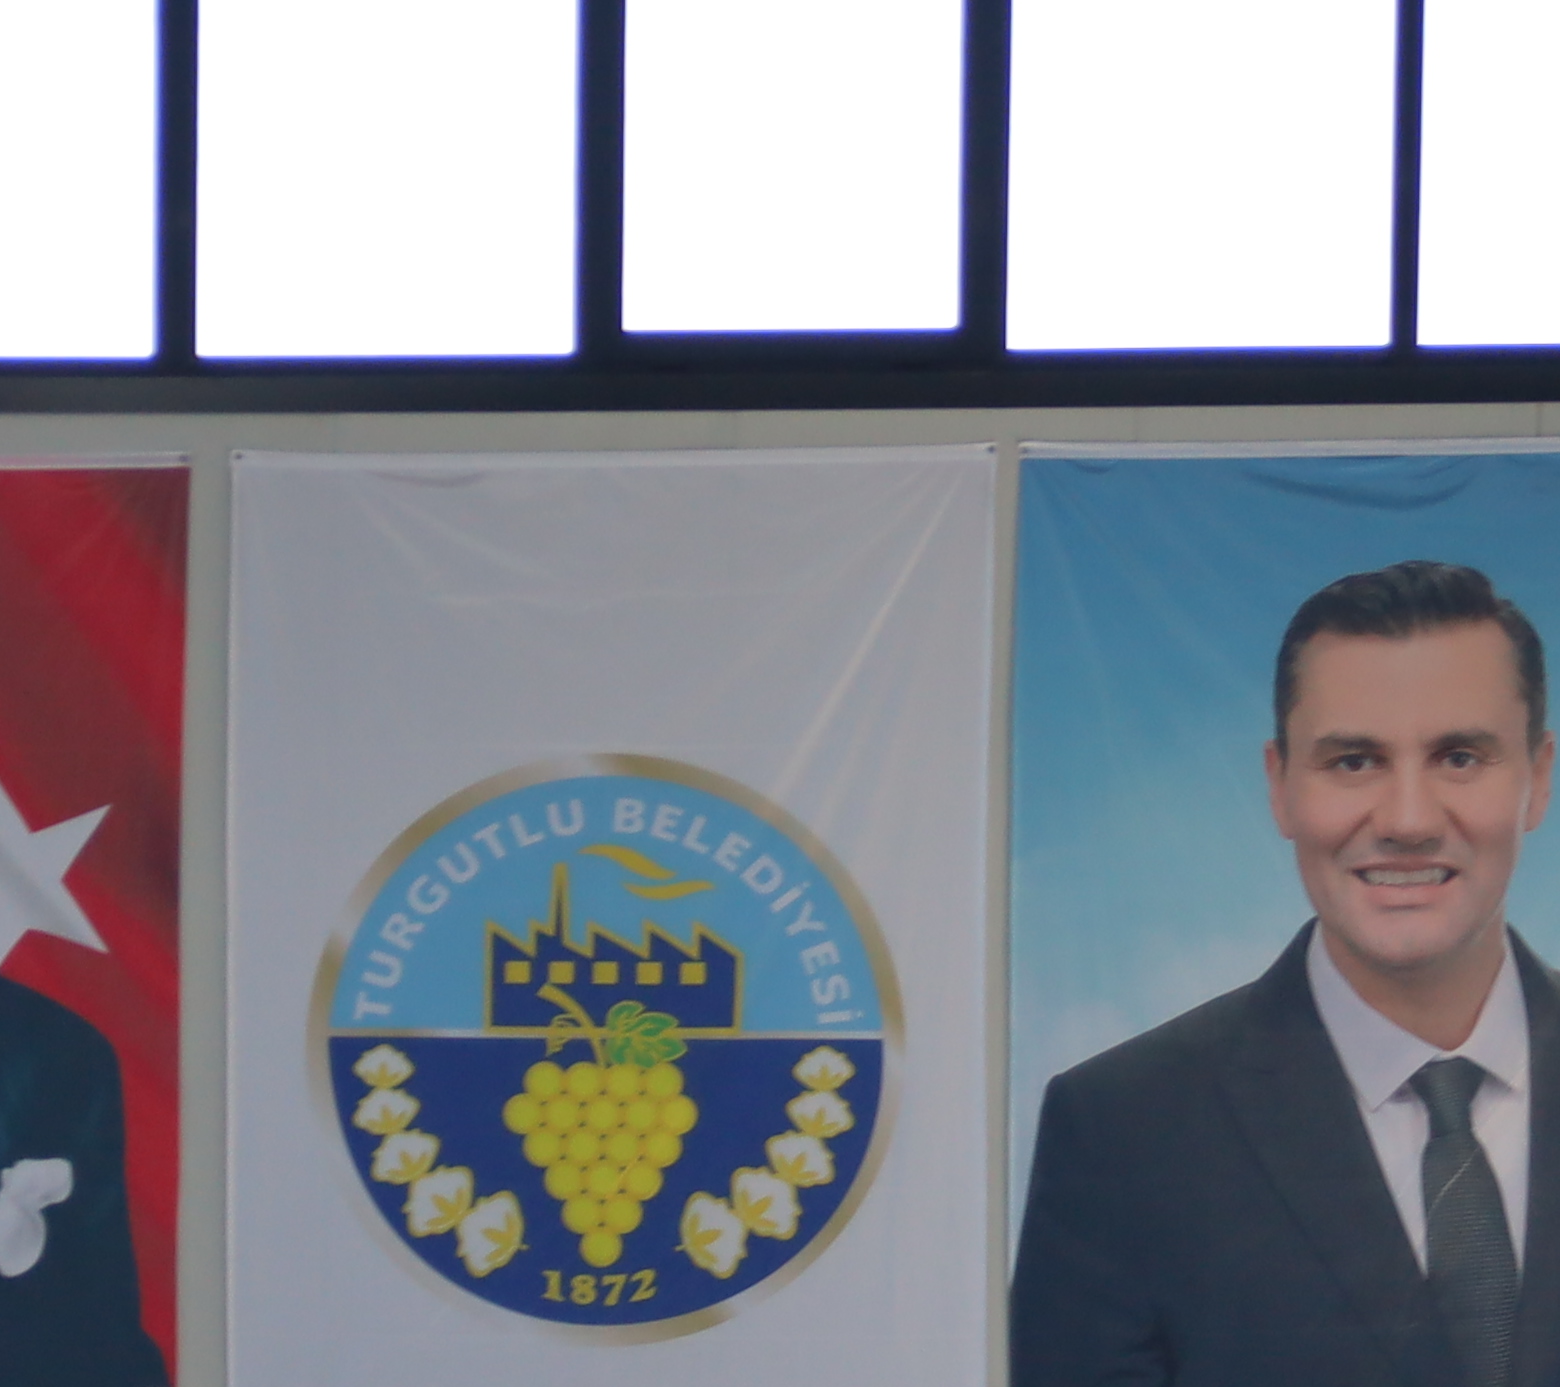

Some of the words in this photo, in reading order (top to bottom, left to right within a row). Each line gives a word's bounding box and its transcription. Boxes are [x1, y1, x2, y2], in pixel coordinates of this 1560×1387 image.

[352, 798, 587, 1021] TURGUTLU
[612, 798, 866, 1025] BELEDİYESİ
[541, 1268, 659, 1308] 1872
